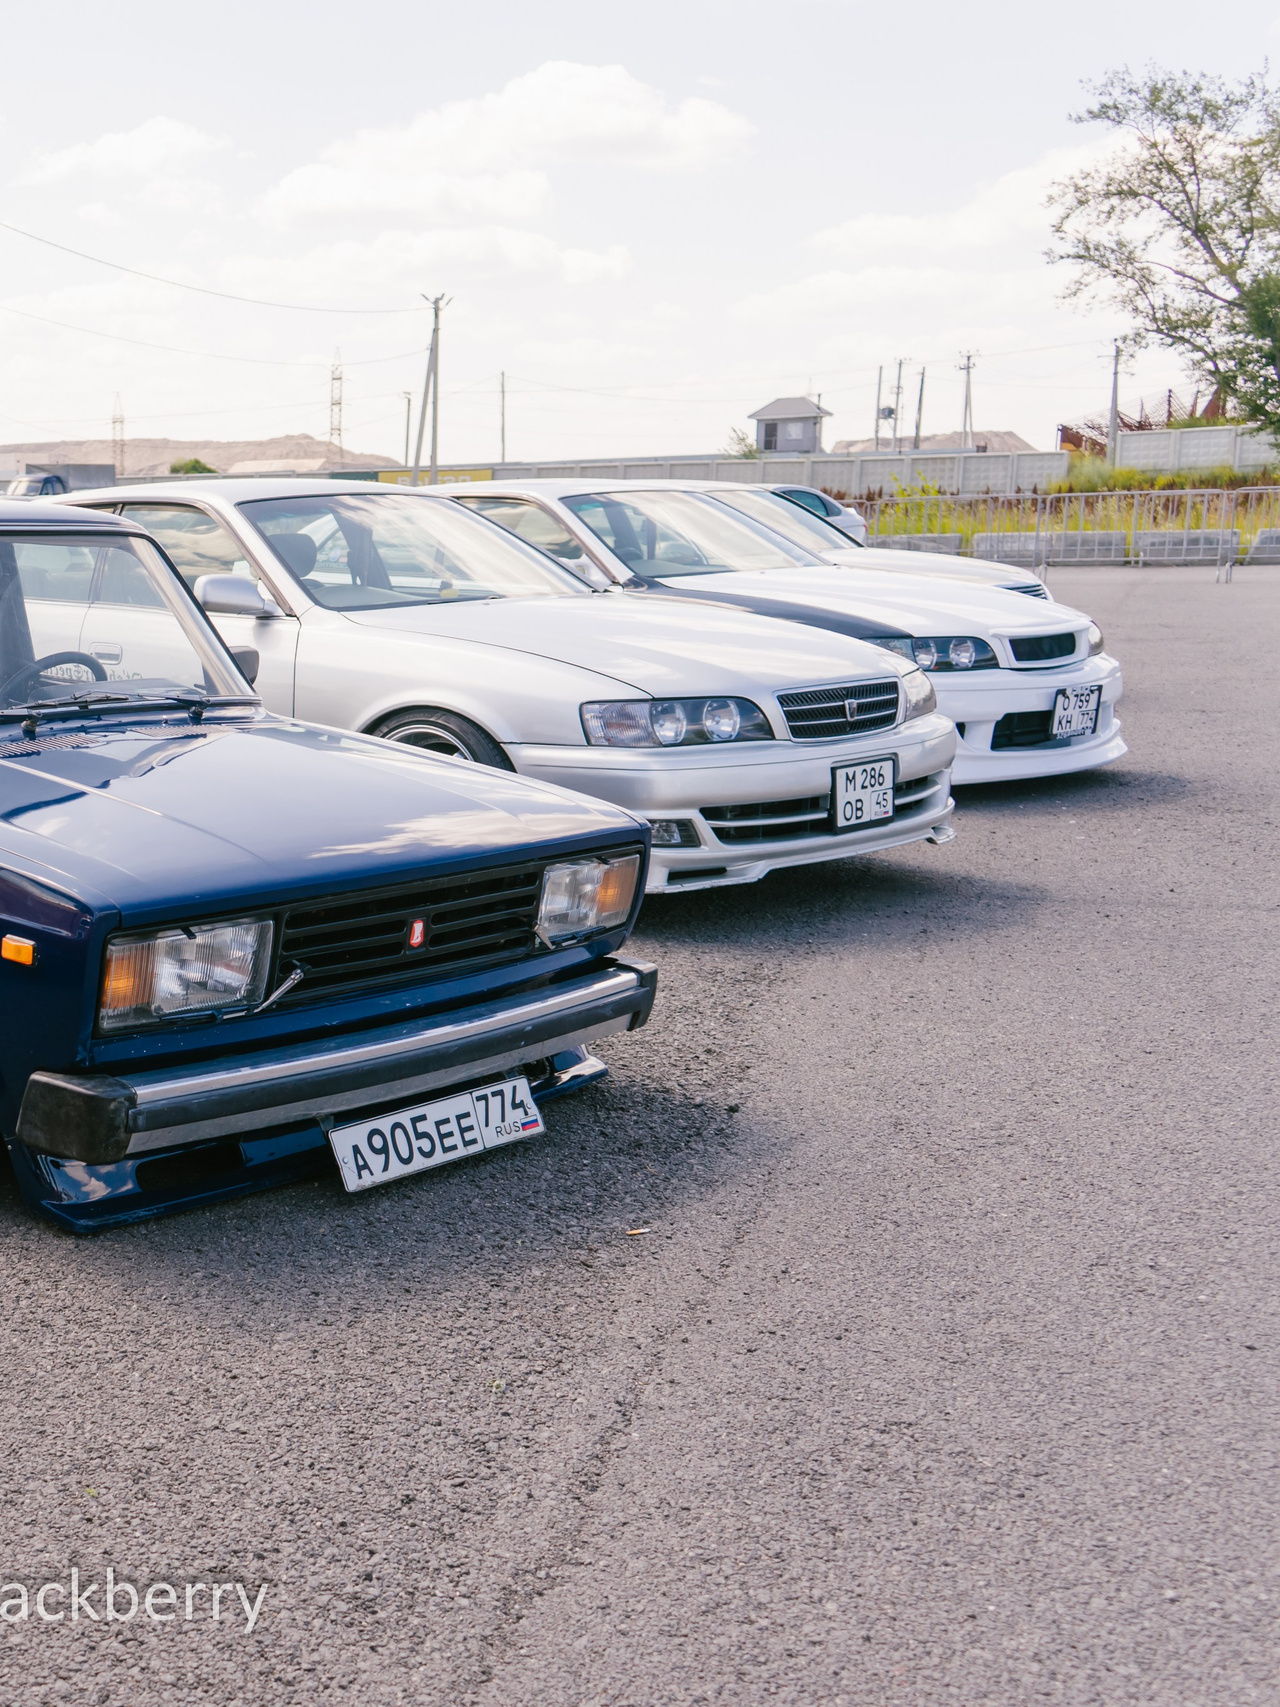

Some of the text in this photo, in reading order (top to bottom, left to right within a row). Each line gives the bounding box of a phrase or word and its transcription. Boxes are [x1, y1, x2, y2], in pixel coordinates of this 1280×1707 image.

[1073, 693, 1090, 710] 759
[861, 765, 885, 790] 286
[875, 792, 888, 809] 45
[475, 1085, 530, 1128] 774
[495, 1122, 521, 1138] RUS
